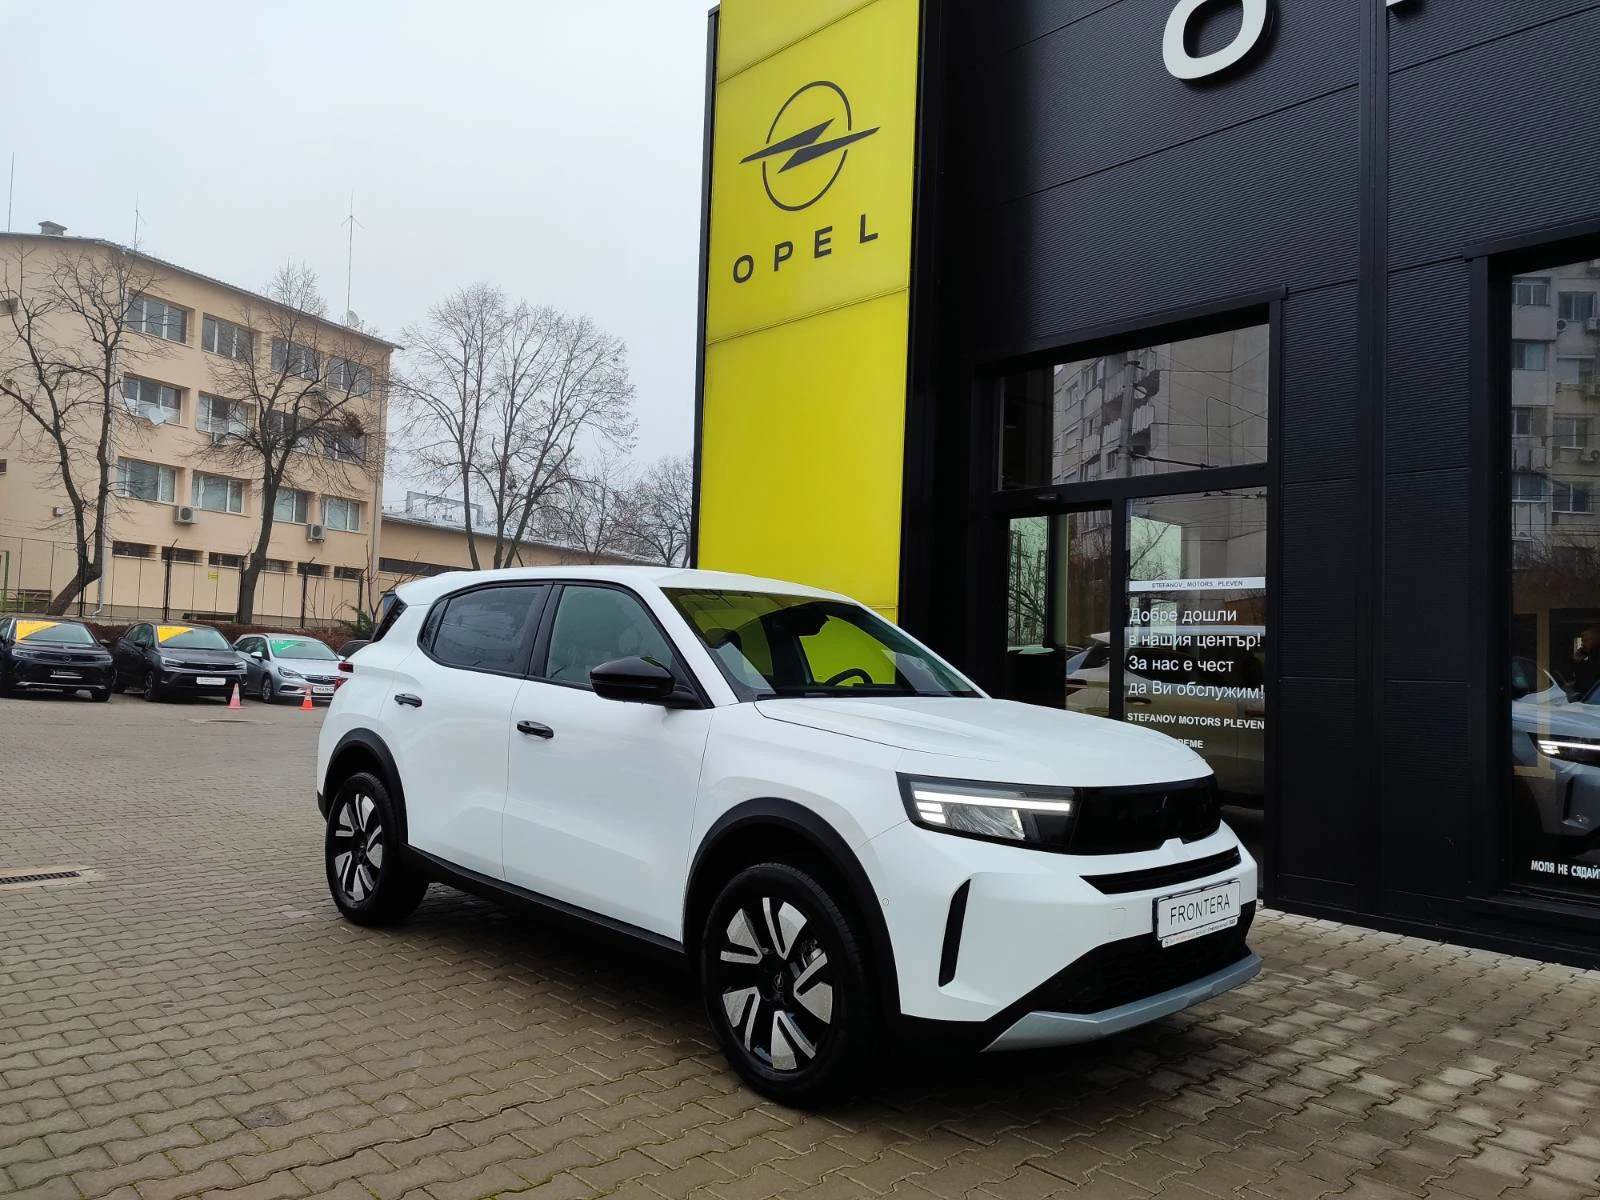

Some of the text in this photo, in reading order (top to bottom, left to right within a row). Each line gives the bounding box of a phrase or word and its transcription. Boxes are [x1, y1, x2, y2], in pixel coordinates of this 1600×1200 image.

[732, 214, 879, 284] OPEL
[1130, 608, 1237, 624] Добре дошли
[1129, 633, 1261, 651] в нашия център!
[1129, 655, 1234, 672] За нас е чест
[1129, 681, 1264, 701] да Ви обслужим!
[1127, 713, 1265, 730] STEFANOV MOTORS PLEVEN
[1531, 860, 1600, 879] МОЛЯ НЕ СЯДАЙ
[1170, 893, 1231, 926] FRONTERA
